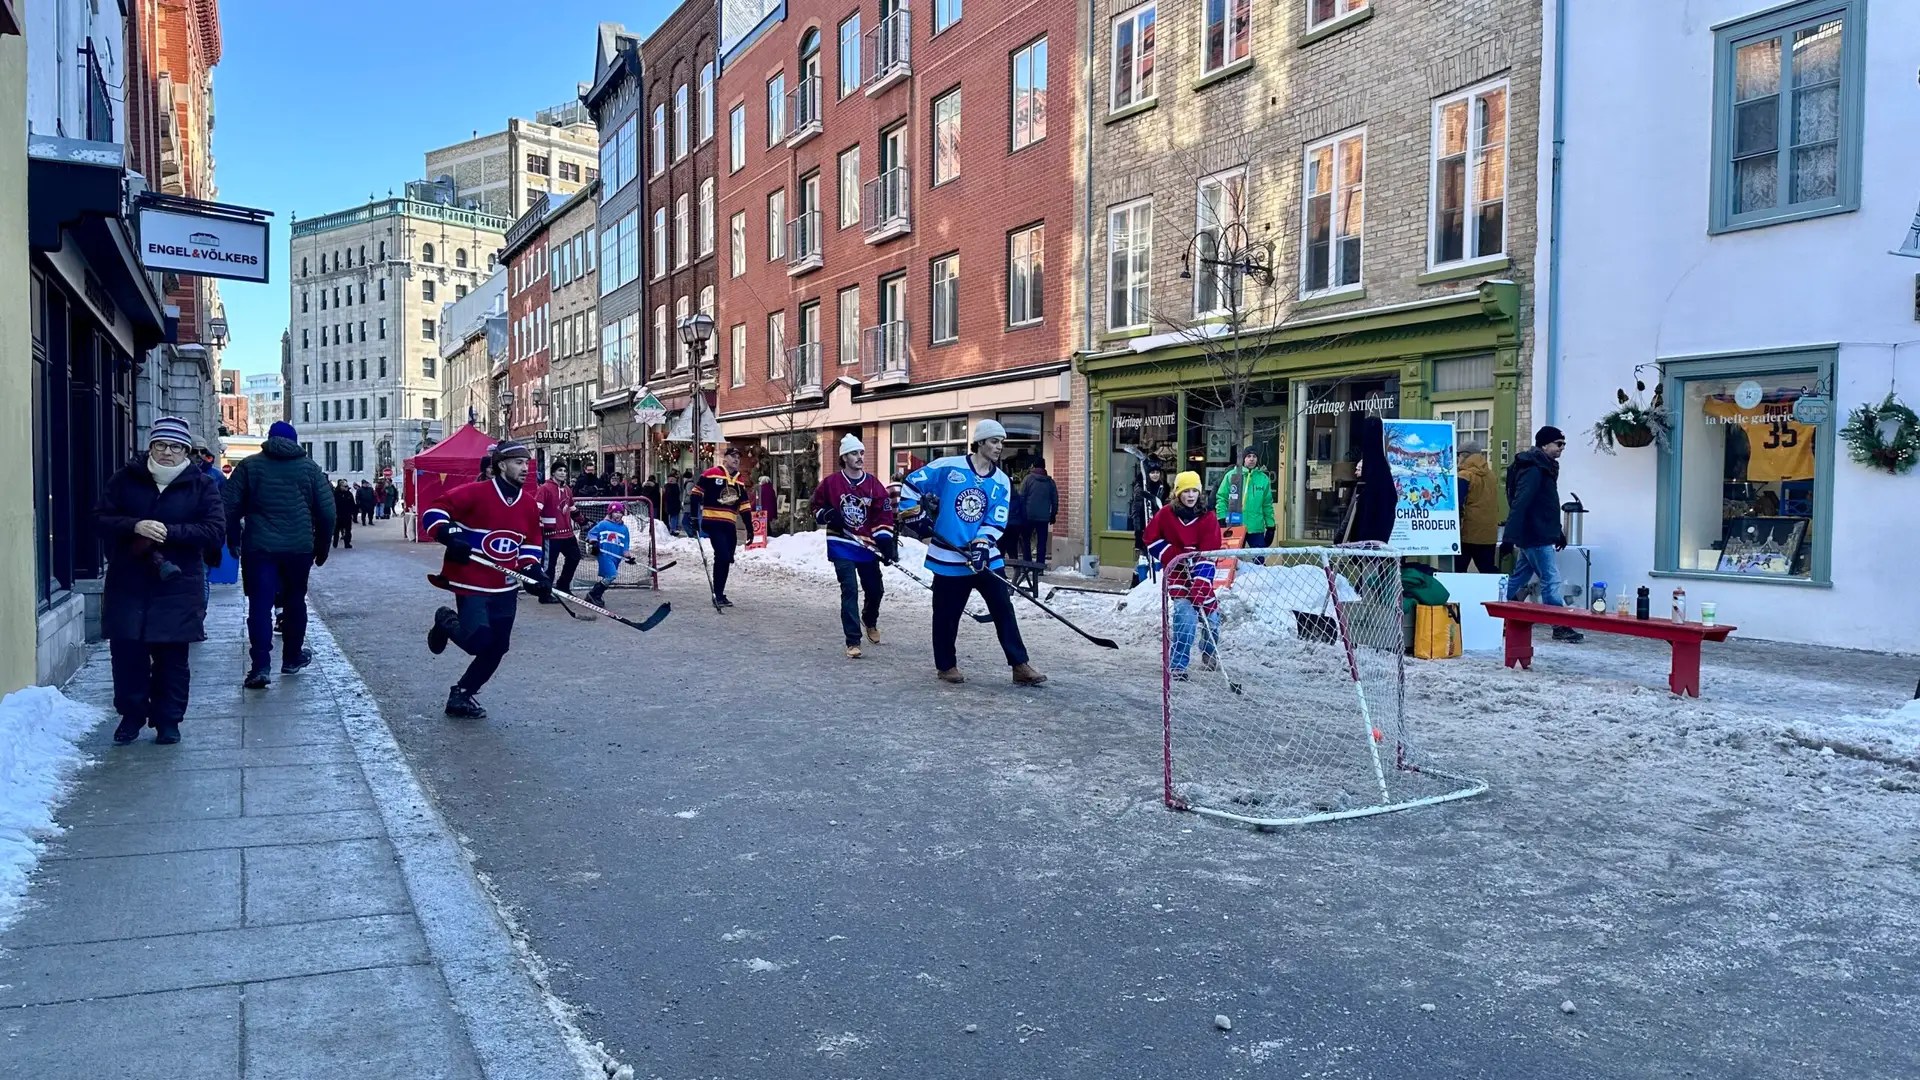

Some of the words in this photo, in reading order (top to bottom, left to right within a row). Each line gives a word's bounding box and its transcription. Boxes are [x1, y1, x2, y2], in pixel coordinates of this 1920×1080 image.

[1112, 414, 1142, 430] l'Héritage
[1144, 412, 1176, 427] ANTIQUITÉ
[1705, 415, 1716, 425] la
[1720, 413, 1748, 425] belle
[1751, 411, 1794, 424] galerie
[538, 432, 569, 440] BOLDUC
[1763, 419, 1798, 449] 35
[1396, 508, 1430, 519] CHARD
[1411, 520, 1457, 530] BRODEUR
